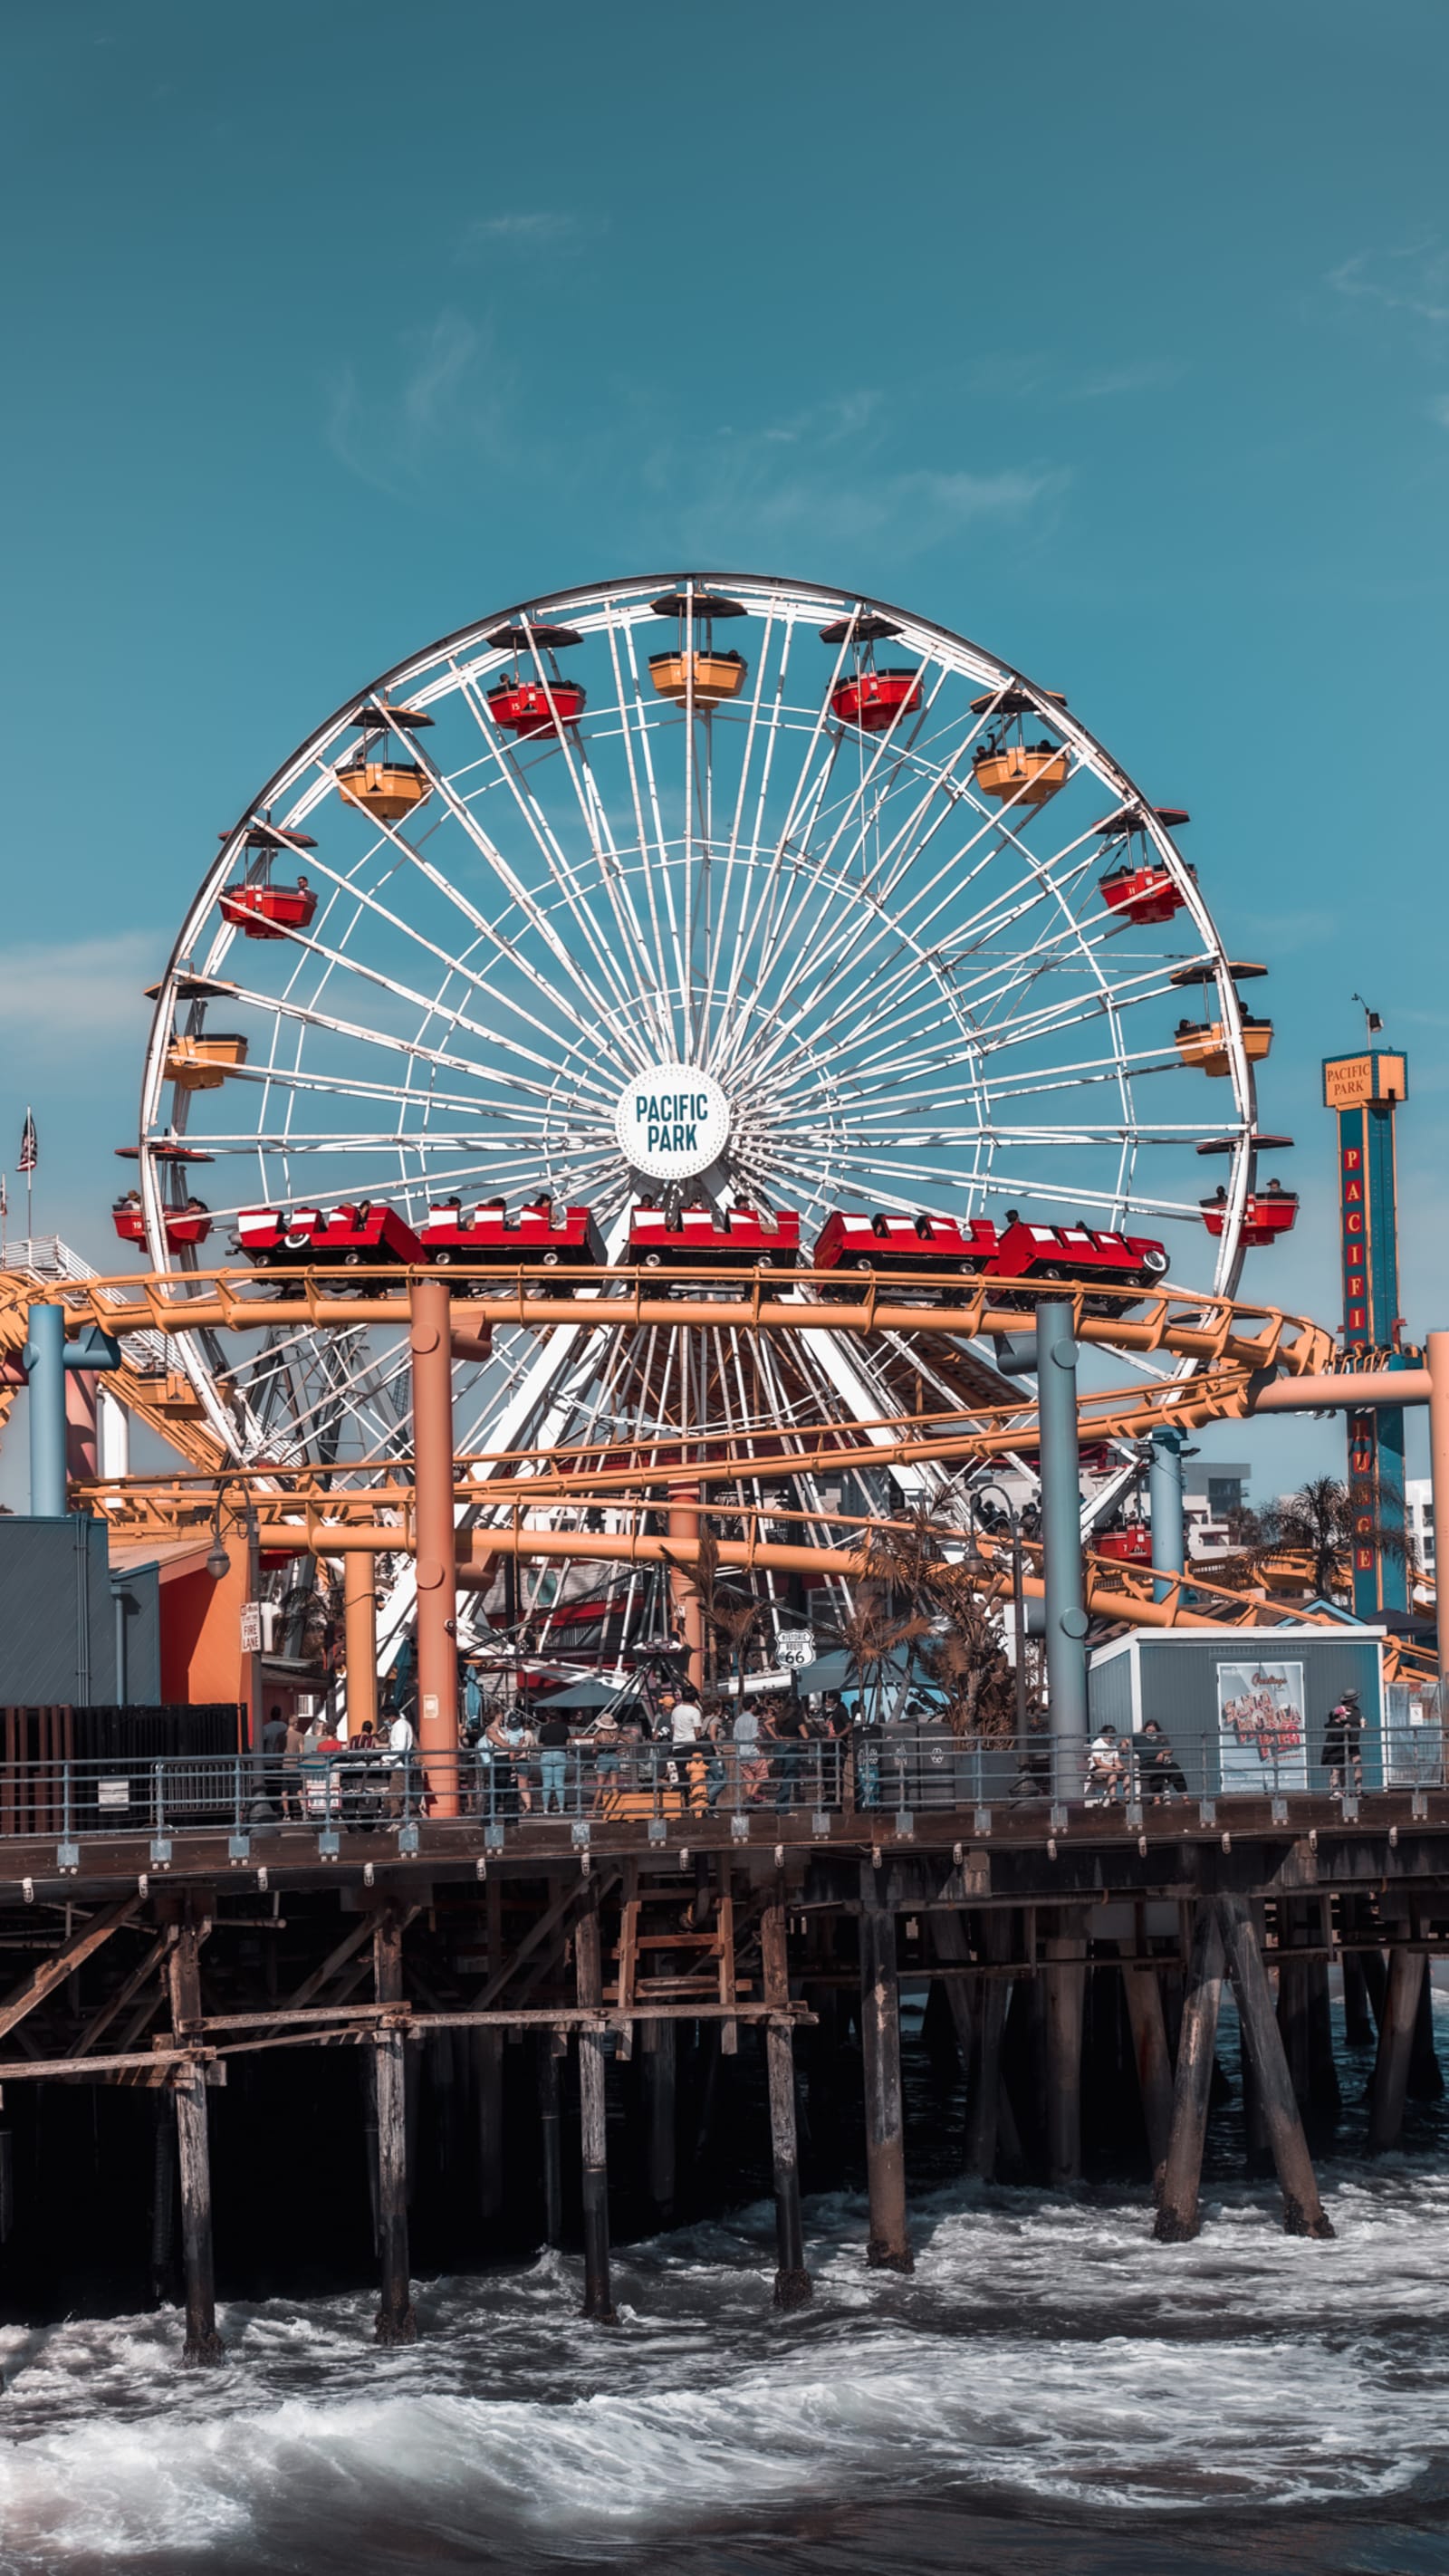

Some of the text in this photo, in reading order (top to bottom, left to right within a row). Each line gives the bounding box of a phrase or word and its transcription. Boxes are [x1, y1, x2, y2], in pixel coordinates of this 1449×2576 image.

[1327, 1063, 1370, 1082] PACIFIC
[1334, 1080, 1364, 1096] PARK
[636, 1093, 708, 1123] PACIFIC
[648, 1124, 697, 1152] PARK
[132, 1221, 142, 1229] 19
[244, 1624, 257, 1637] FIRE
[243, 1637, 259, 1649] LANE
[785, 1650, 804, 1664] 66
[1224, 1688, 1272, 1724] SANTA
[1238, 1703, 1301, 1743] MONICA
[1260, 1724, 1301, 1758] PER
